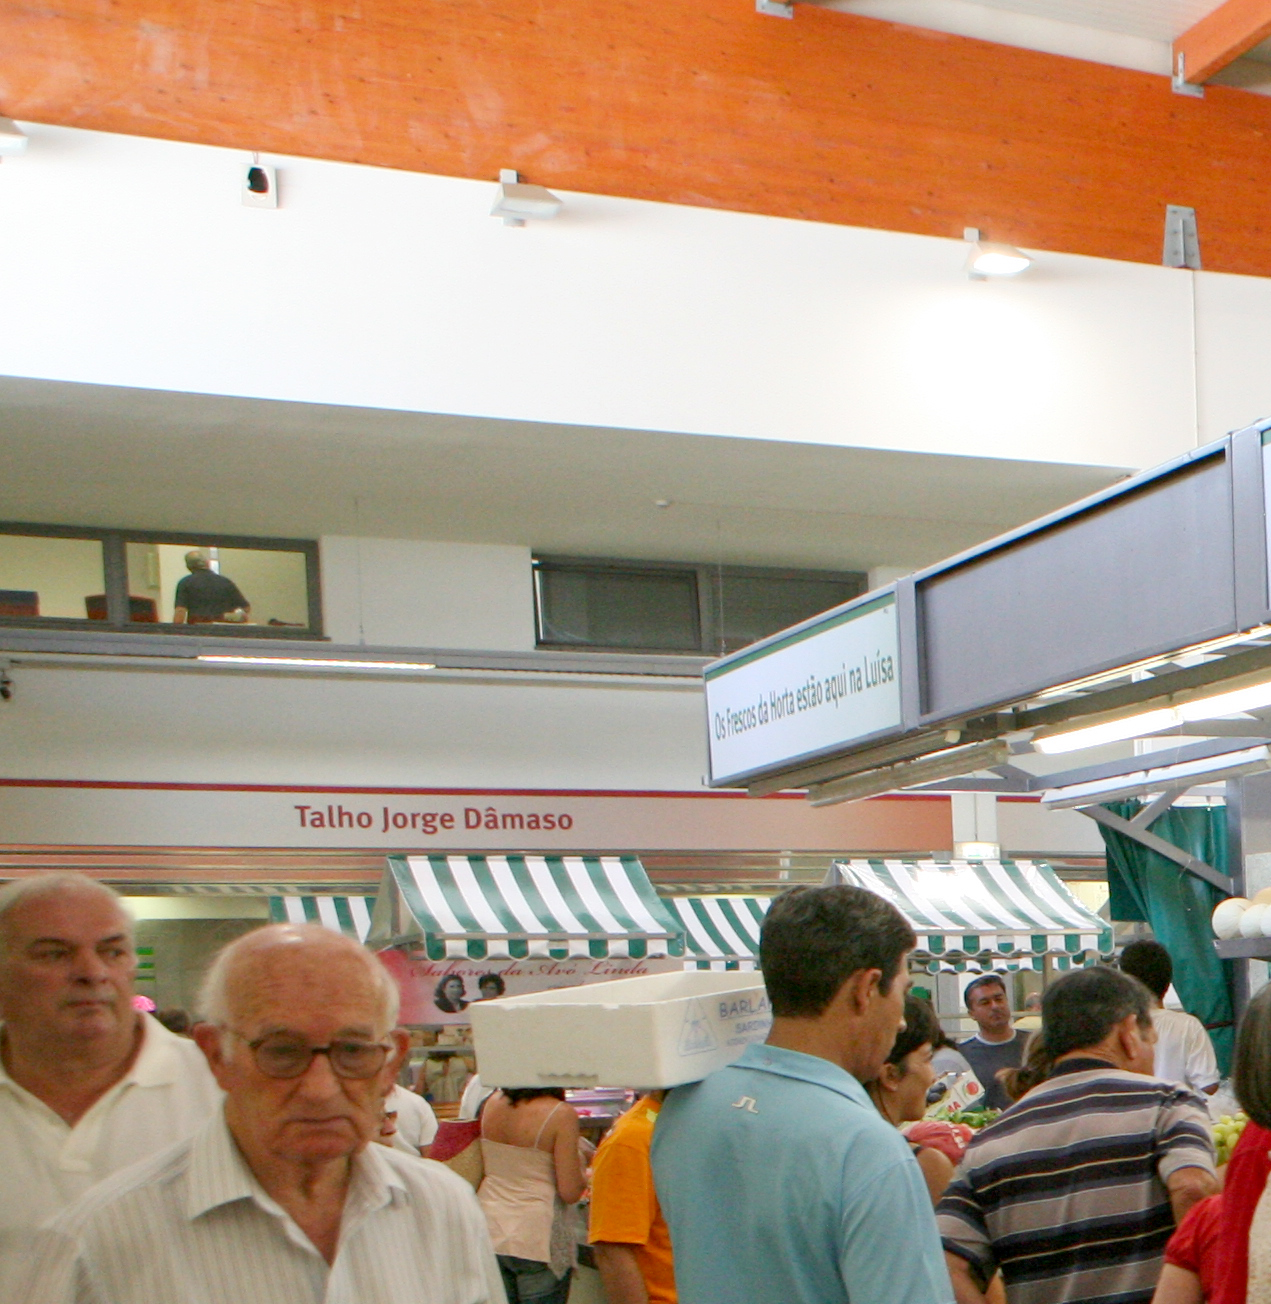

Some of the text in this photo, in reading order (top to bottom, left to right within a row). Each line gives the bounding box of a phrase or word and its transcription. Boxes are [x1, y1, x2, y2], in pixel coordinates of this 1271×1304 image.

[714, 649, 894, 741] Os Frescos da Horta estão aqui na Luísa
[294, 805, 574, 836] Talho Jorge Dâmaso
[499, 962, 523, 977] da
[583, 960, 650, 977] Linda
[719, 997, 773, 1019] BARLA
